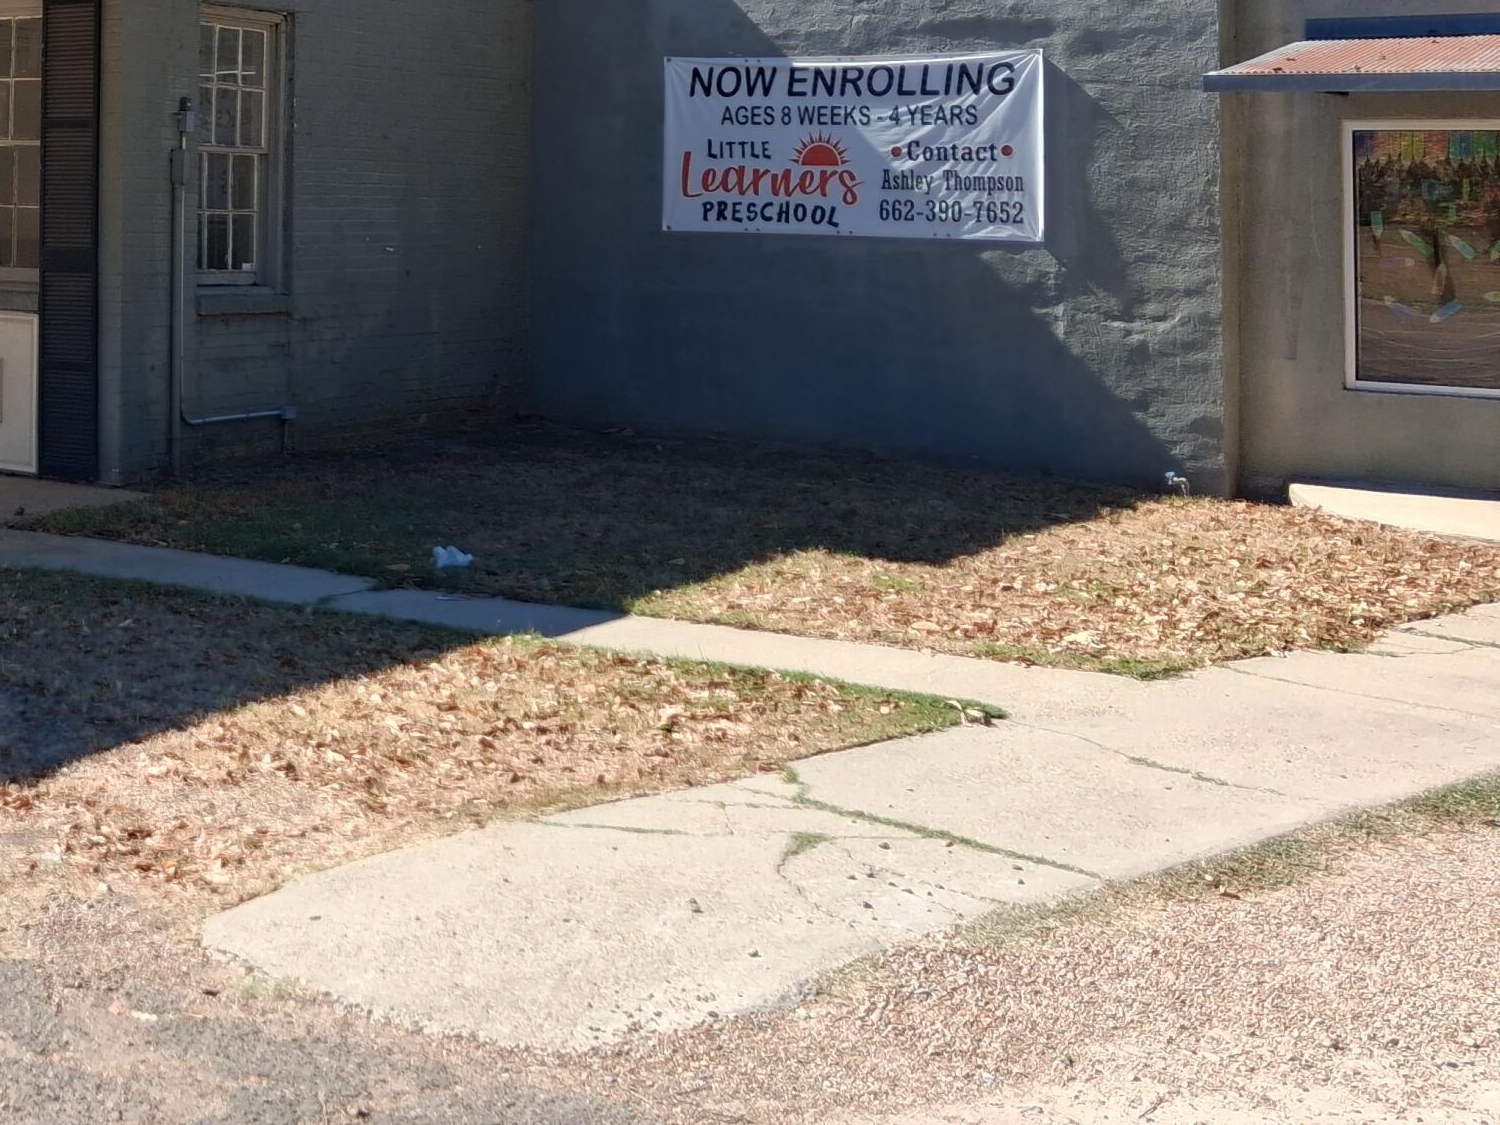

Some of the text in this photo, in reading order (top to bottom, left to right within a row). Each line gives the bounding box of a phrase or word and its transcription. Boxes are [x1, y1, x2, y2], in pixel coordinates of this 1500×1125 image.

[689, 62, 1015, 97] NOW ENROLLING
[721, 105, 775, 125] AGES
[781, 106, 792, 125] 8
[797, 105, 871, 125] WEEKS
[888, 105, 900, 125] 4
[906, 104, 978, 125] YEARS
[707, 139, 772, 159] LITTLE
[907, 140, 998, 162] Contact
[681, 151, 864, 205] Learners
[881, 169, 1024, 196] Ashley Thompson
[702, 200, 840, 228] PRESCHOOL
[879, 199, 1024, 224] 662-390-7652
